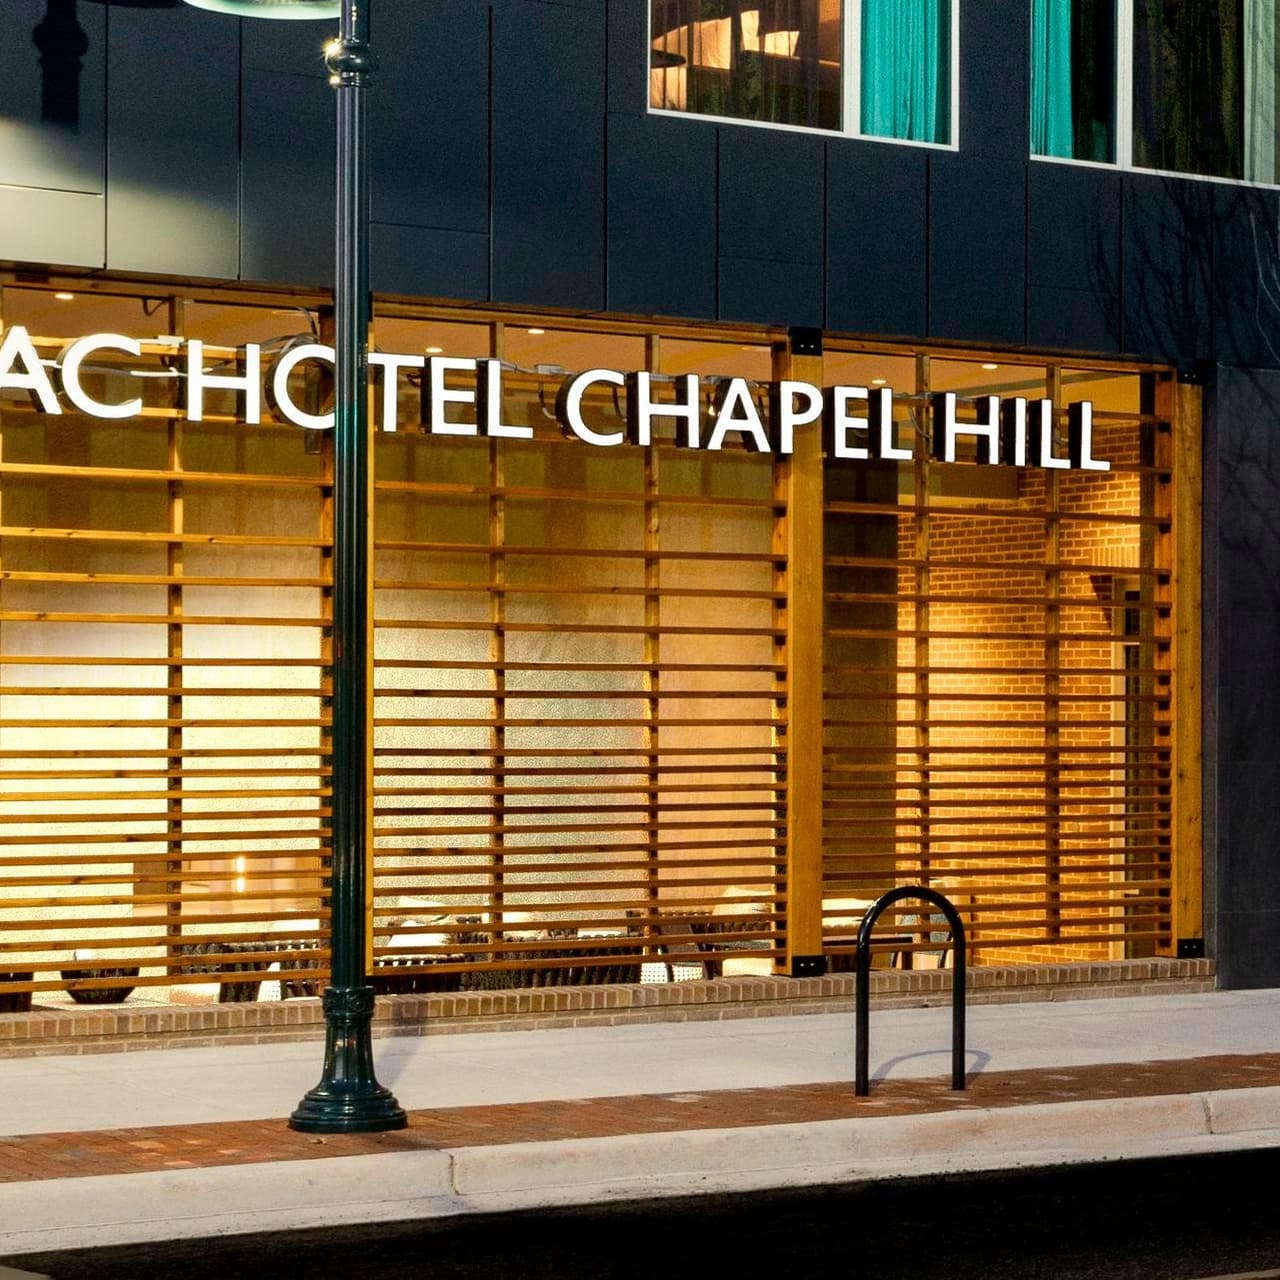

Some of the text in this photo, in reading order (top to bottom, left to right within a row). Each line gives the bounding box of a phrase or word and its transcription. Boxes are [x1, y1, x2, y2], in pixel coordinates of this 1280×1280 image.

[186, 338, 534, 438] HOTEL
[566, 368, 914, 460] CHAPEL
[944, 391, 1111, 470] HILL
